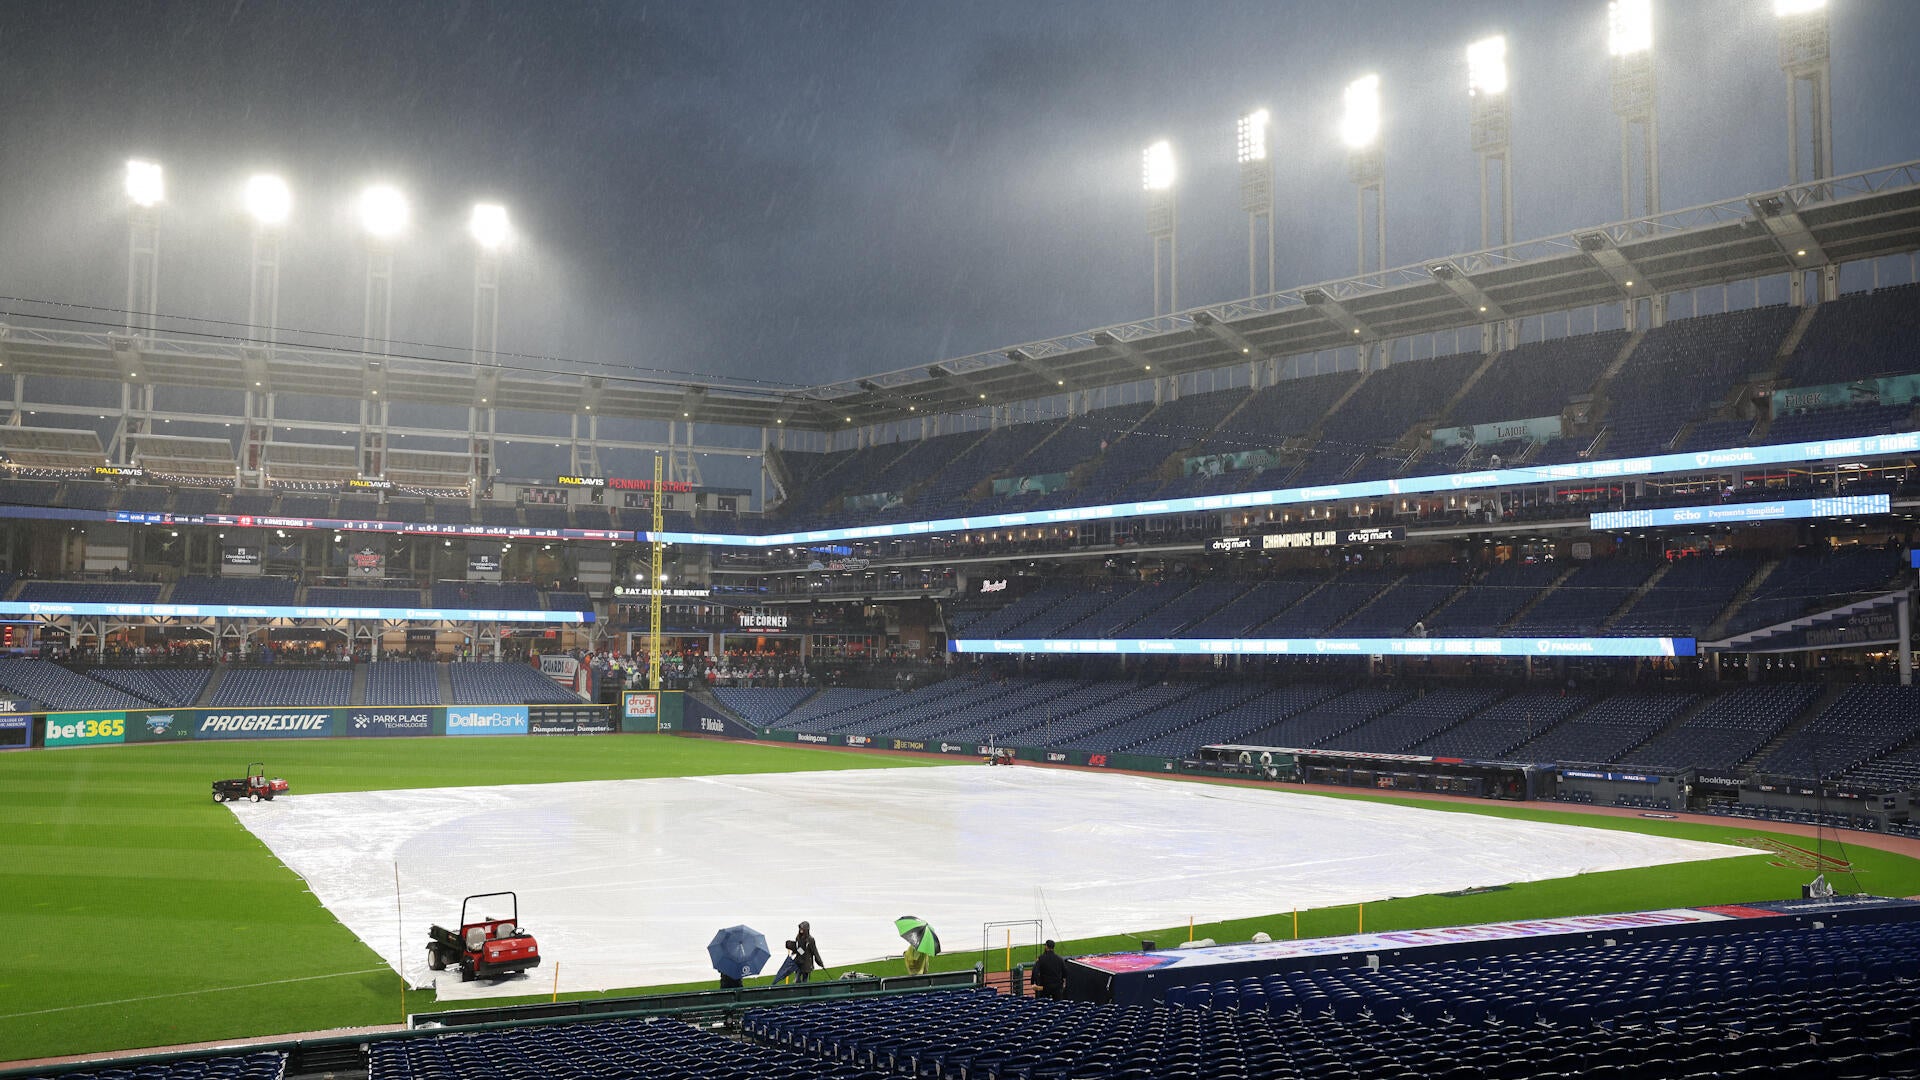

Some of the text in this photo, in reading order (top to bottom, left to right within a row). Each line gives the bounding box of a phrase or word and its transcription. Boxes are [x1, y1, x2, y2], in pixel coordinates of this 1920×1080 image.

[1711, 452, 1756, 464] FANDUEL
[608, 478, 651, 490] PENNANT
[1674, 510, 1701, 520] echo
[1708, 510, 1744, 518] Payments
[1746, 506, 1784, 515] Simplified
[1263, 531, 1336, 548] CHAMPIONS CLUB
[1348, 530, 1392, 542] drug mart
[1212, 541, 1230, 550] drug
[1232, 539, 1251, 548] mart
[740, 616, 788, 627] THE CORNER
[1848, 617, 1869, 626] drug
[1552, 642, 1593, 650] FANDUEL
[628, 695, 651, 707] drug
[630, 705, 656, 714] mart
[200, 714, 327, 731] PROGRESSIVE
[373, 714, 428, 723] PARK PLACE
[46, 719, 124, 739] bet365
[798, 734, 827, 743] Booking.com
[1090, 754, 1107, 764] ACE
